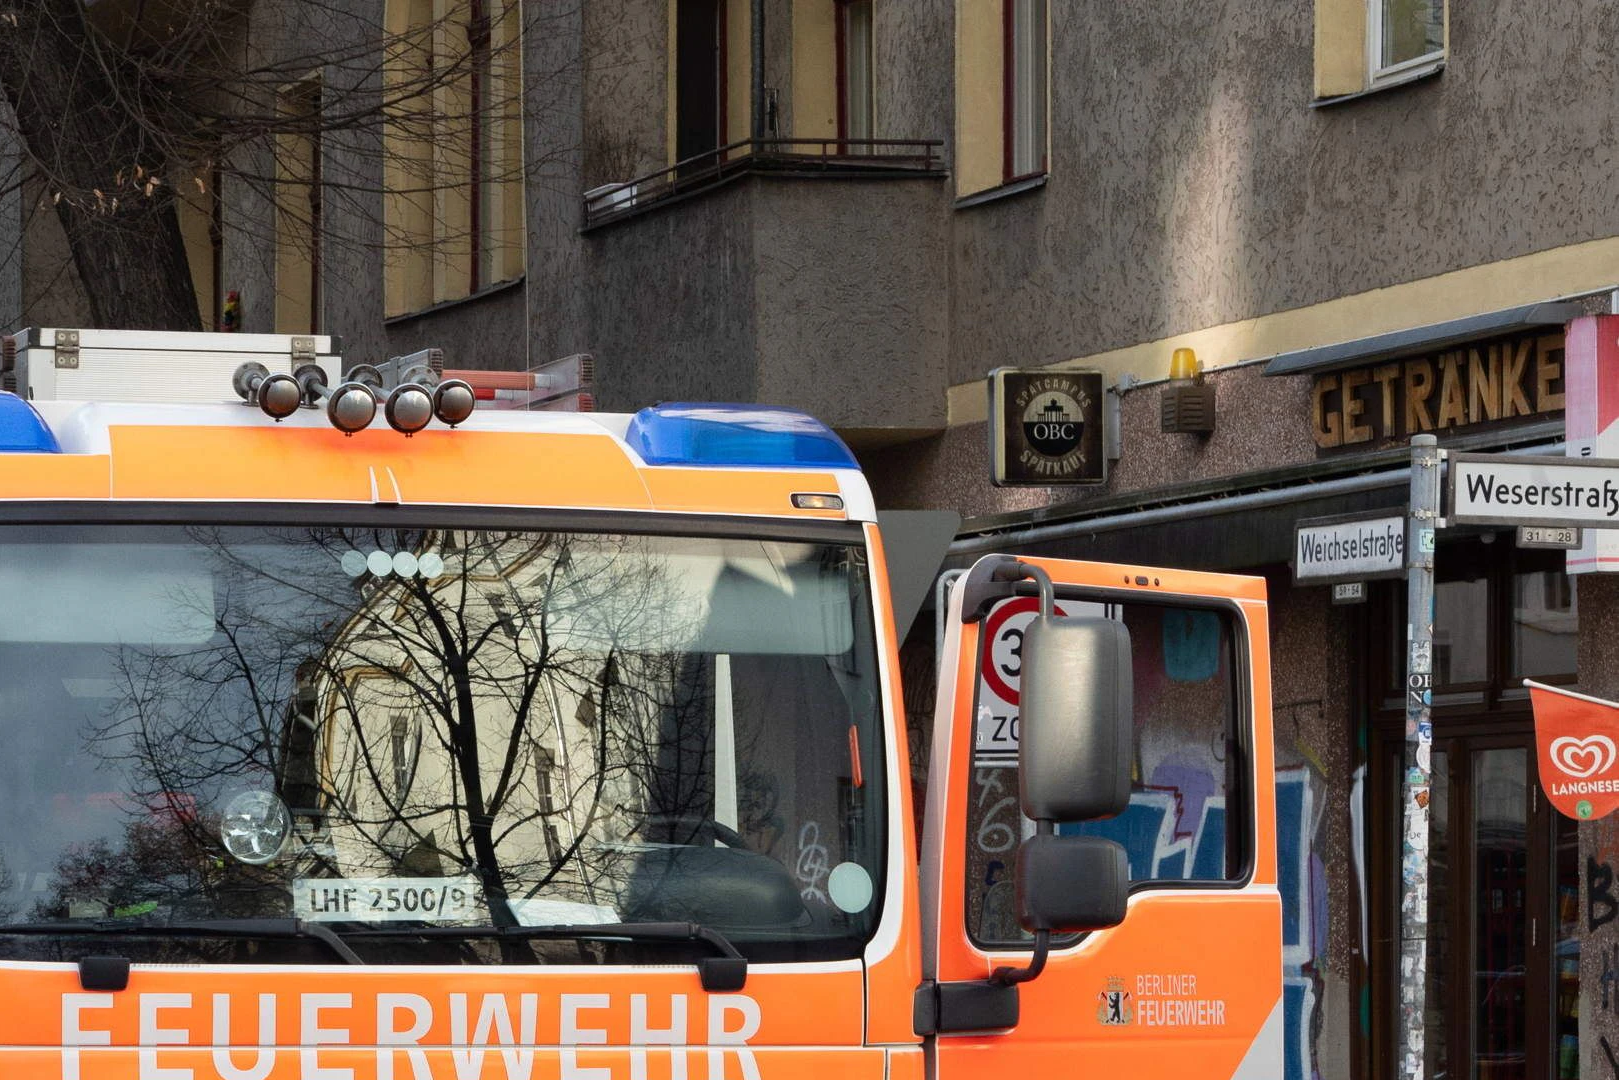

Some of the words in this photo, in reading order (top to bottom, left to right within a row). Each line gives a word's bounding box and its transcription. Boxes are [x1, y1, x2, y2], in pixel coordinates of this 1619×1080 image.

[1311, 333, 1566, 448] GETRÄNKE
[1033, 423, 1075, 440] OBC
[1300, 525, 1404, 564] Weichselstraße
[1526, 531, 1541, 541] 31
[1557, 532, 1572, 542] 28
[1001, 628, 1024, 677] 3
[1552, 780, 1619, 795] LANGNESE
[311, 888, 357, 912] LHF
[369, 885, 466, 916] 2500/9
[1136, 975, 1197, 995] BERLINER
[1137, 999, 1226, 1025] FEUERWEHR
